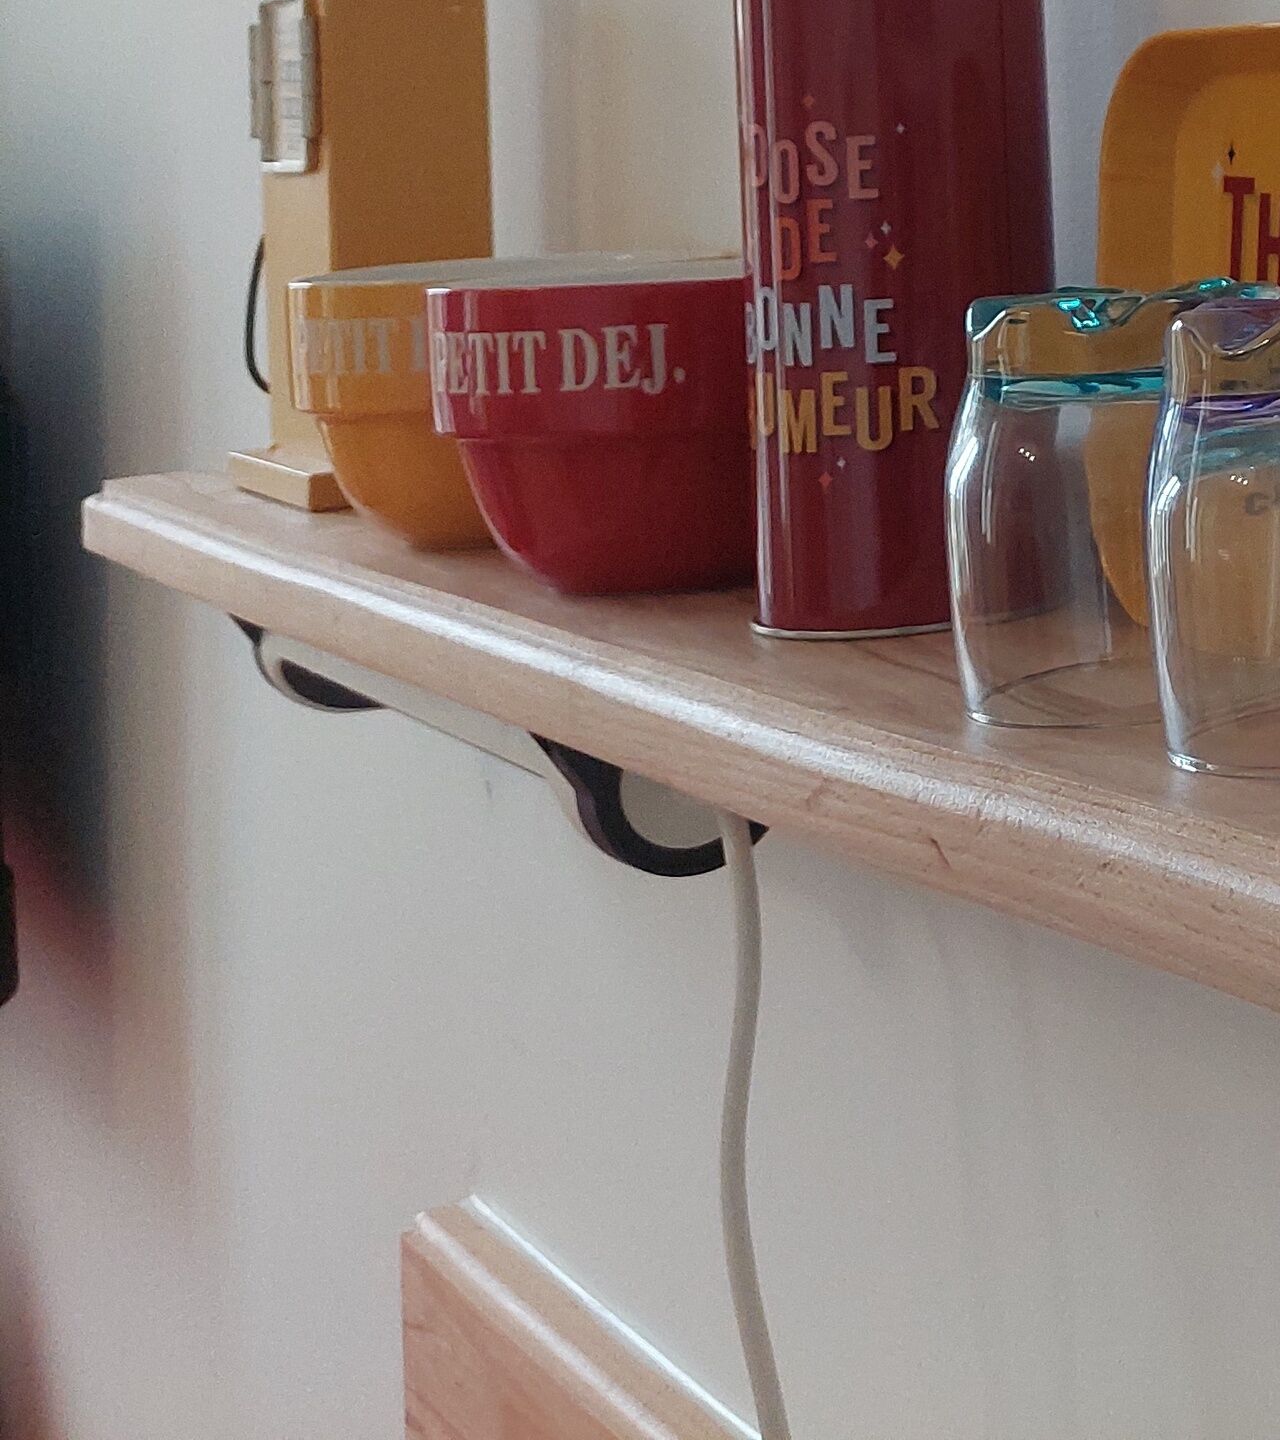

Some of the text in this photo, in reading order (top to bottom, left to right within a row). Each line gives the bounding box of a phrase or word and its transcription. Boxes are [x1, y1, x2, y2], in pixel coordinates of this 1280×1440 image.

[775, 198, 838, 281] DE
[432, 330, 547, 396] PETIT
[557, 322, 687, 396] DEJ.
